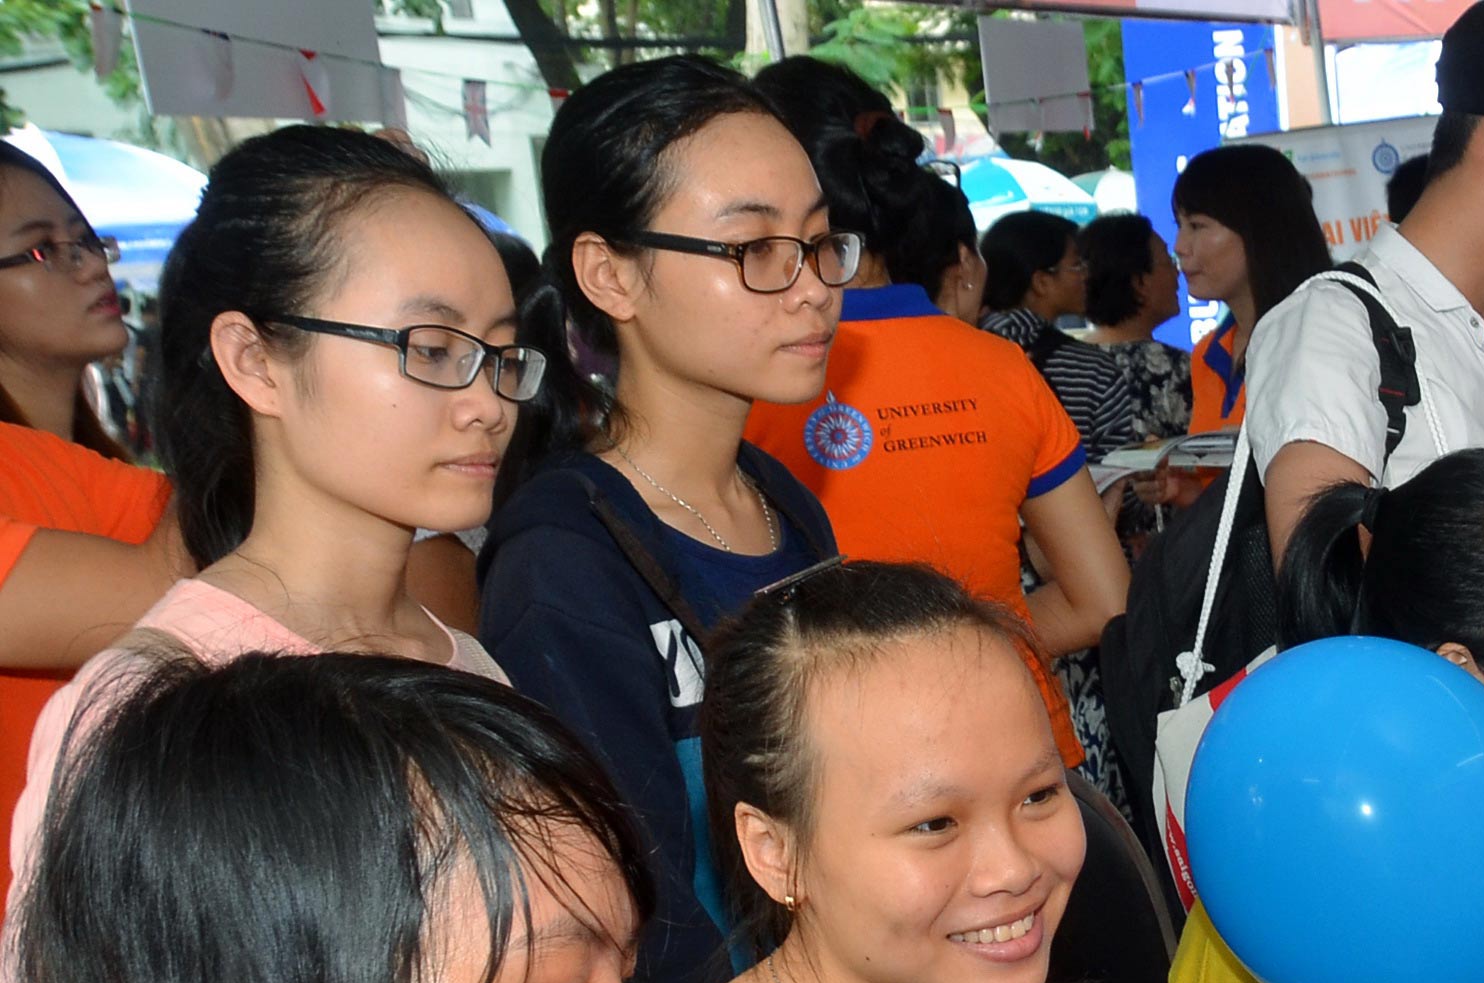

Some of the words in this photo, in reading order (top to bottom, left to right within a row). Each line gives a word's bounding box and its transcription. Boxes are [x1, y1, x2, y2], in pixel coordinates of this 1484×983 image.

[1212, 29, 1250, 139] ATION
[877, 398, 978, 421] UNIVERSITY
[880, 424, 894, 437] of
[883, 431, 988, 453] GREENWICH
